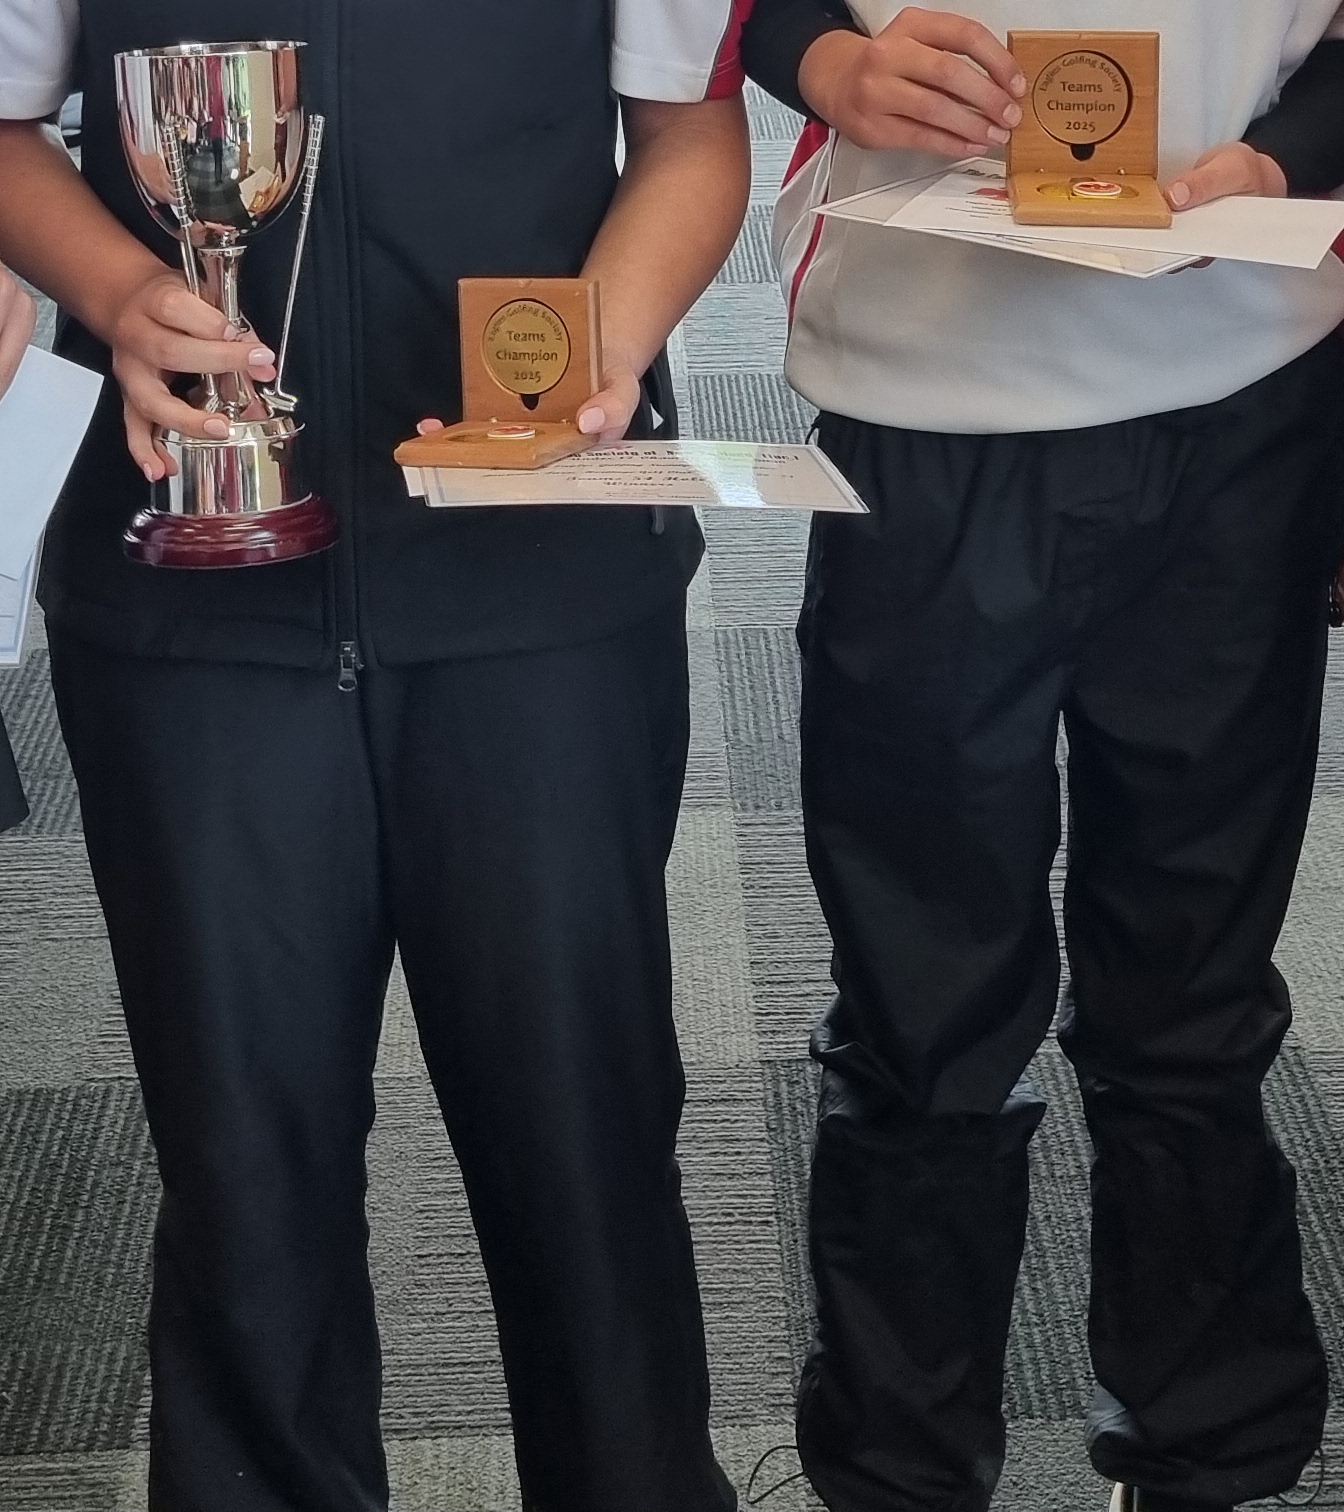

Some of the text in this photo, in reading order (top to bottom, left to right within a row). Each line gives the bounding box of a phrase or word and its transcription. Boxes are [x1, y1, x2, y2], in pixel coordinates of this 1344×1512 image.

[1062, 55, 1097, 68] Golfing
[1098, 62, 1122, 93] Society
[1060, 81, 1103, 93] Teams
[1046, 99, 1115, 115] Champion
[1065, 121, 1096, 133] 2025
[541, 311, 563, 341] Society
[506, 330, 546, 343] Teams
[495, 349, 558, 364] Champion
[513, 370, 542, 384] 2025
